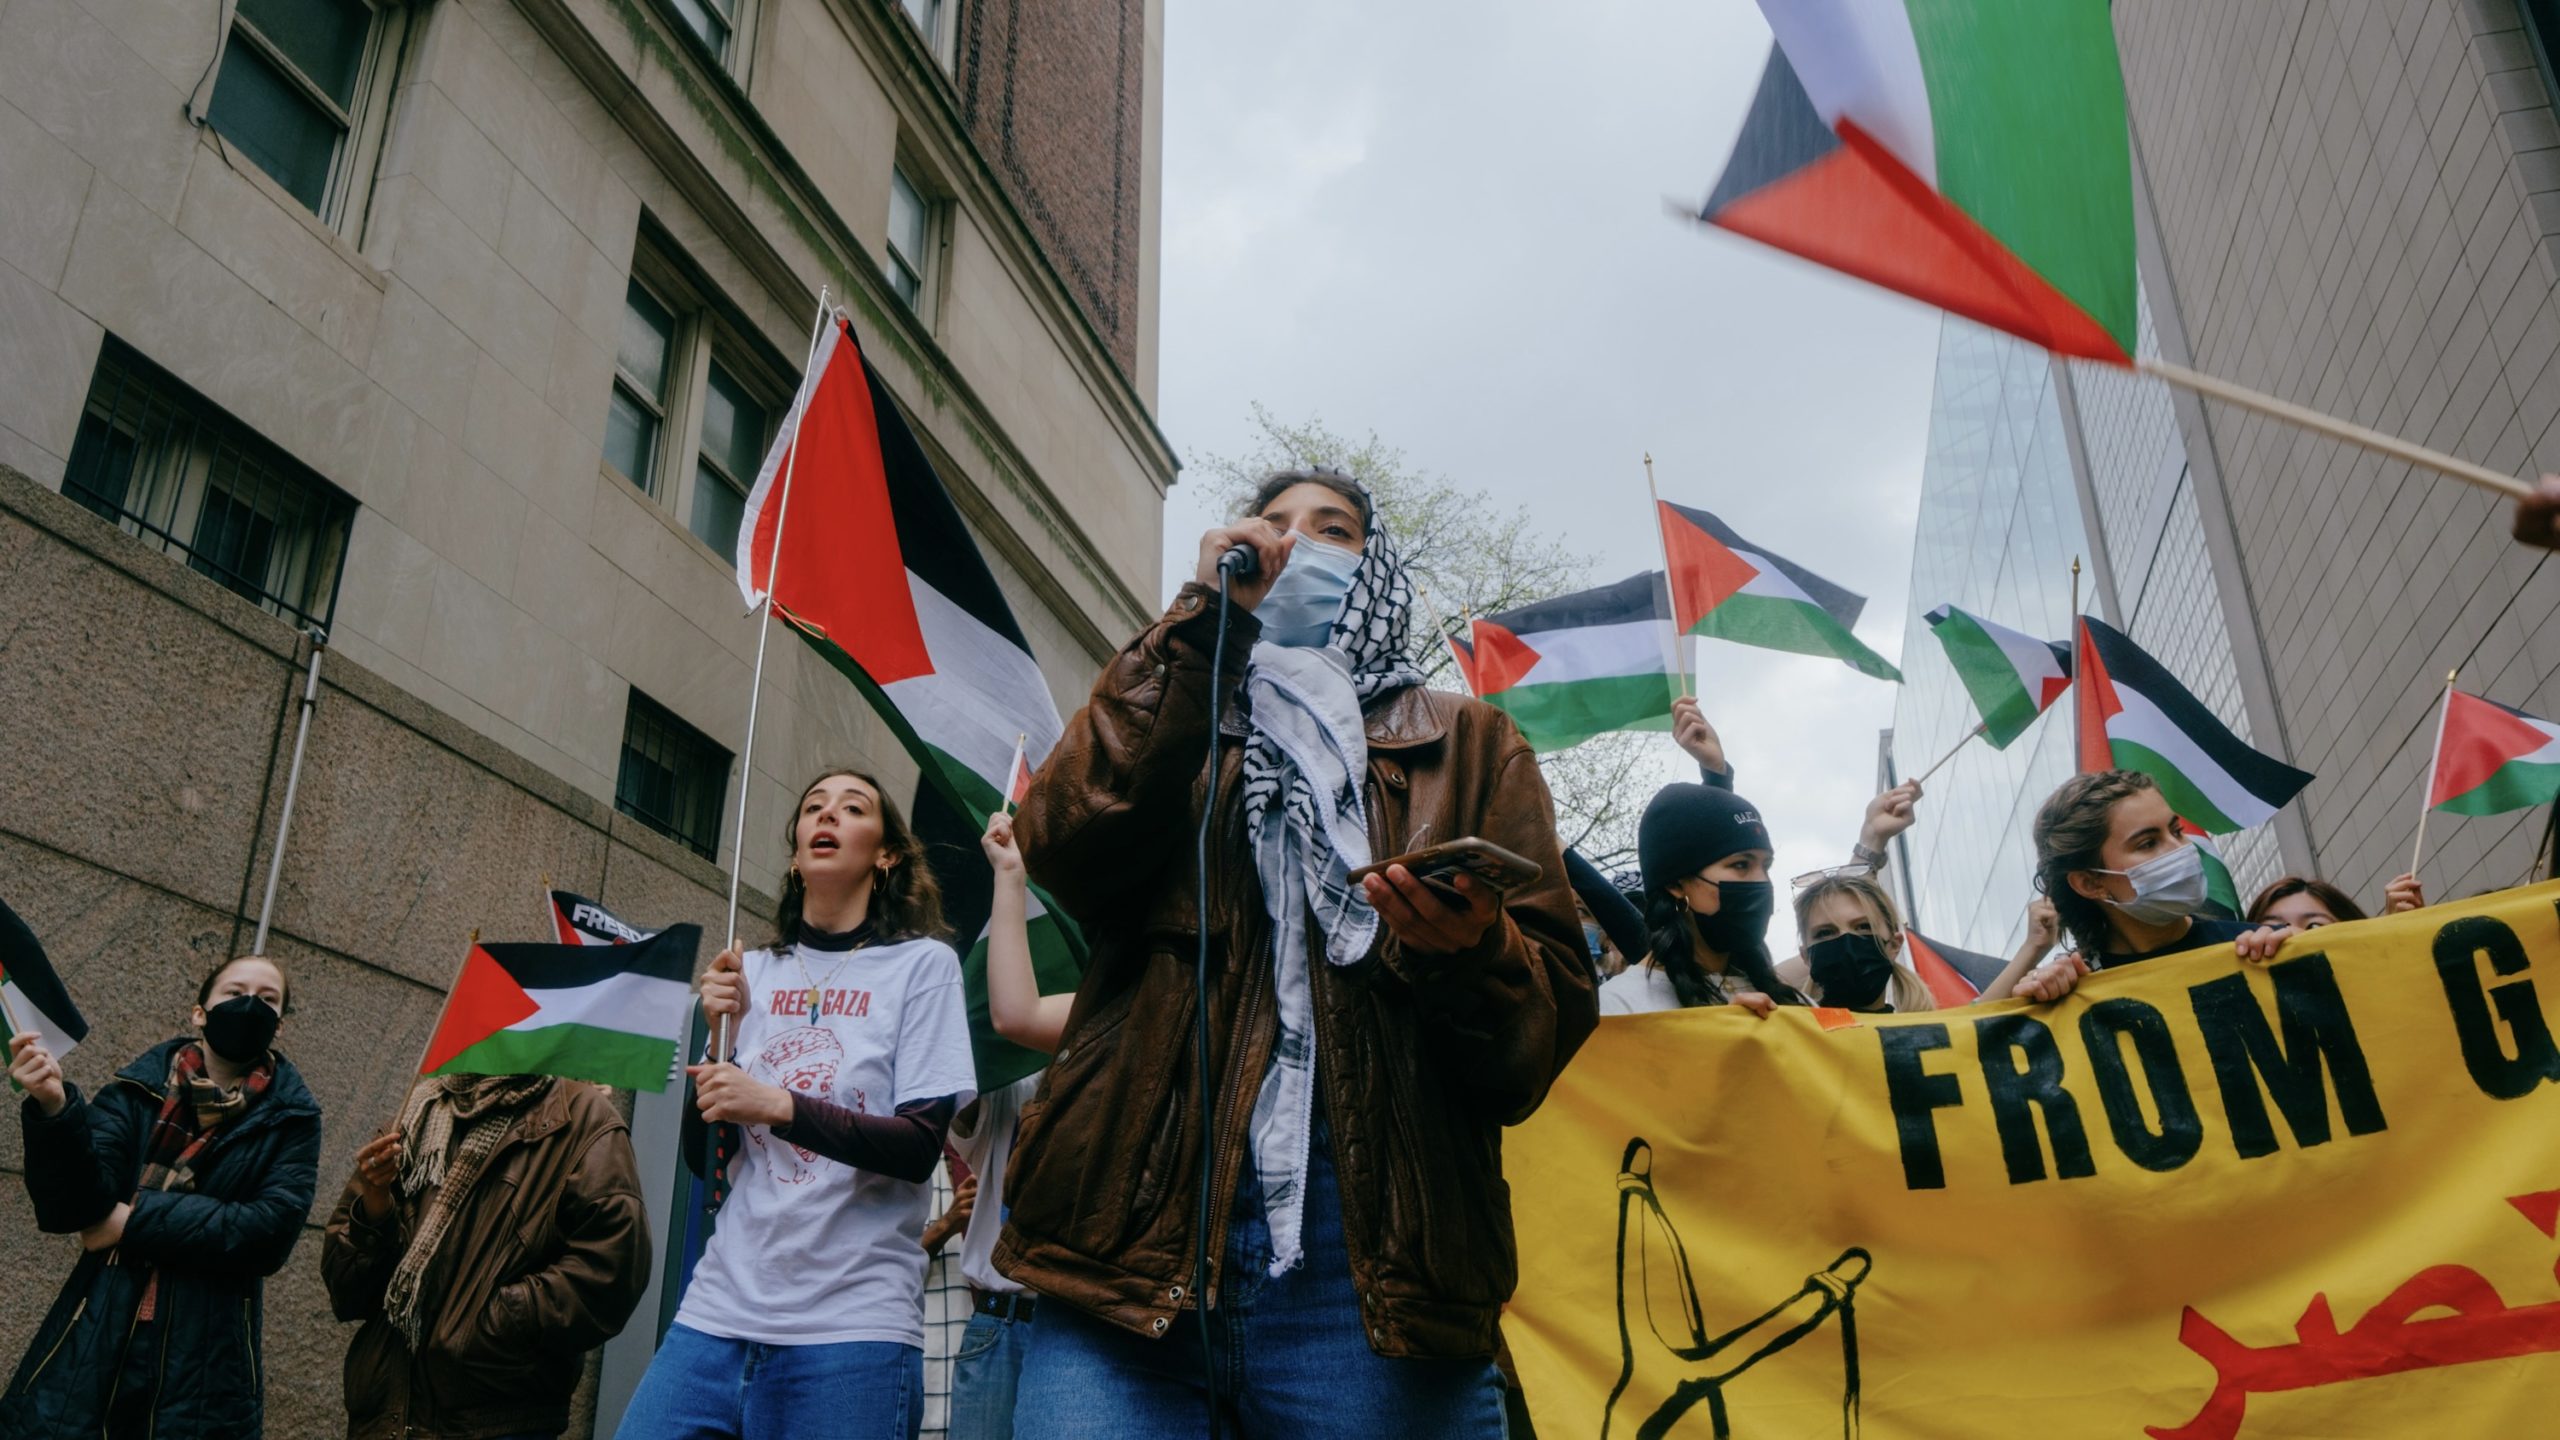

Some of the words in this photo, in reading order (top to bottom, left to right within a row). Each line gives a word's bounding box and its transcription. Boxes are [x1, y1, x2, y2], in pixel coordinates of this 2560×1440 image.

[769, 988, 812, 1016] REE
[821, 988, 872, 1017] GAZA
[1876, 950, 2389, 1190] FROM
